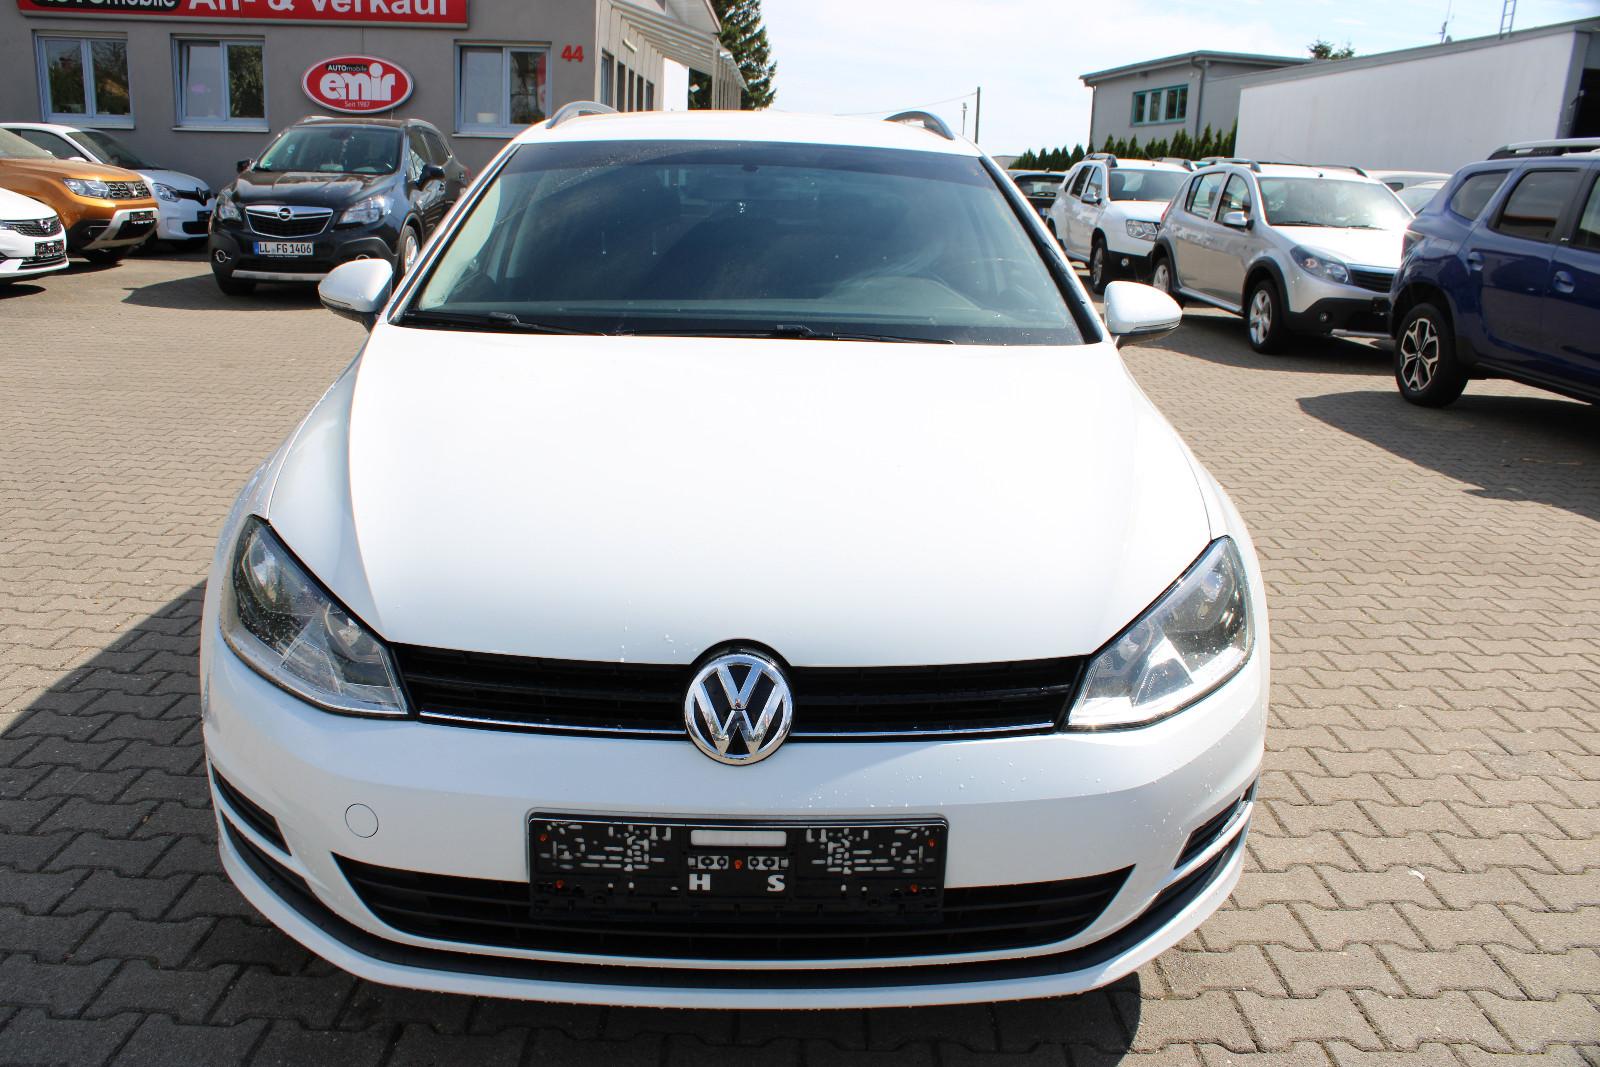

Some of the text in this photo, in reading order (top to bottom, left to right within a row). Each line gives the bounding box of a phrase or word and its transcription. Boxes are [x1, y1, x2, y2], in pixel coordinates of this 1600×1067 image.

[561, 45, 584, 62] 44
[320, 63, 395, 101] emir
[259, 243, 312, 254] LL FG 1406
[688, 873, 786, 892] H S
